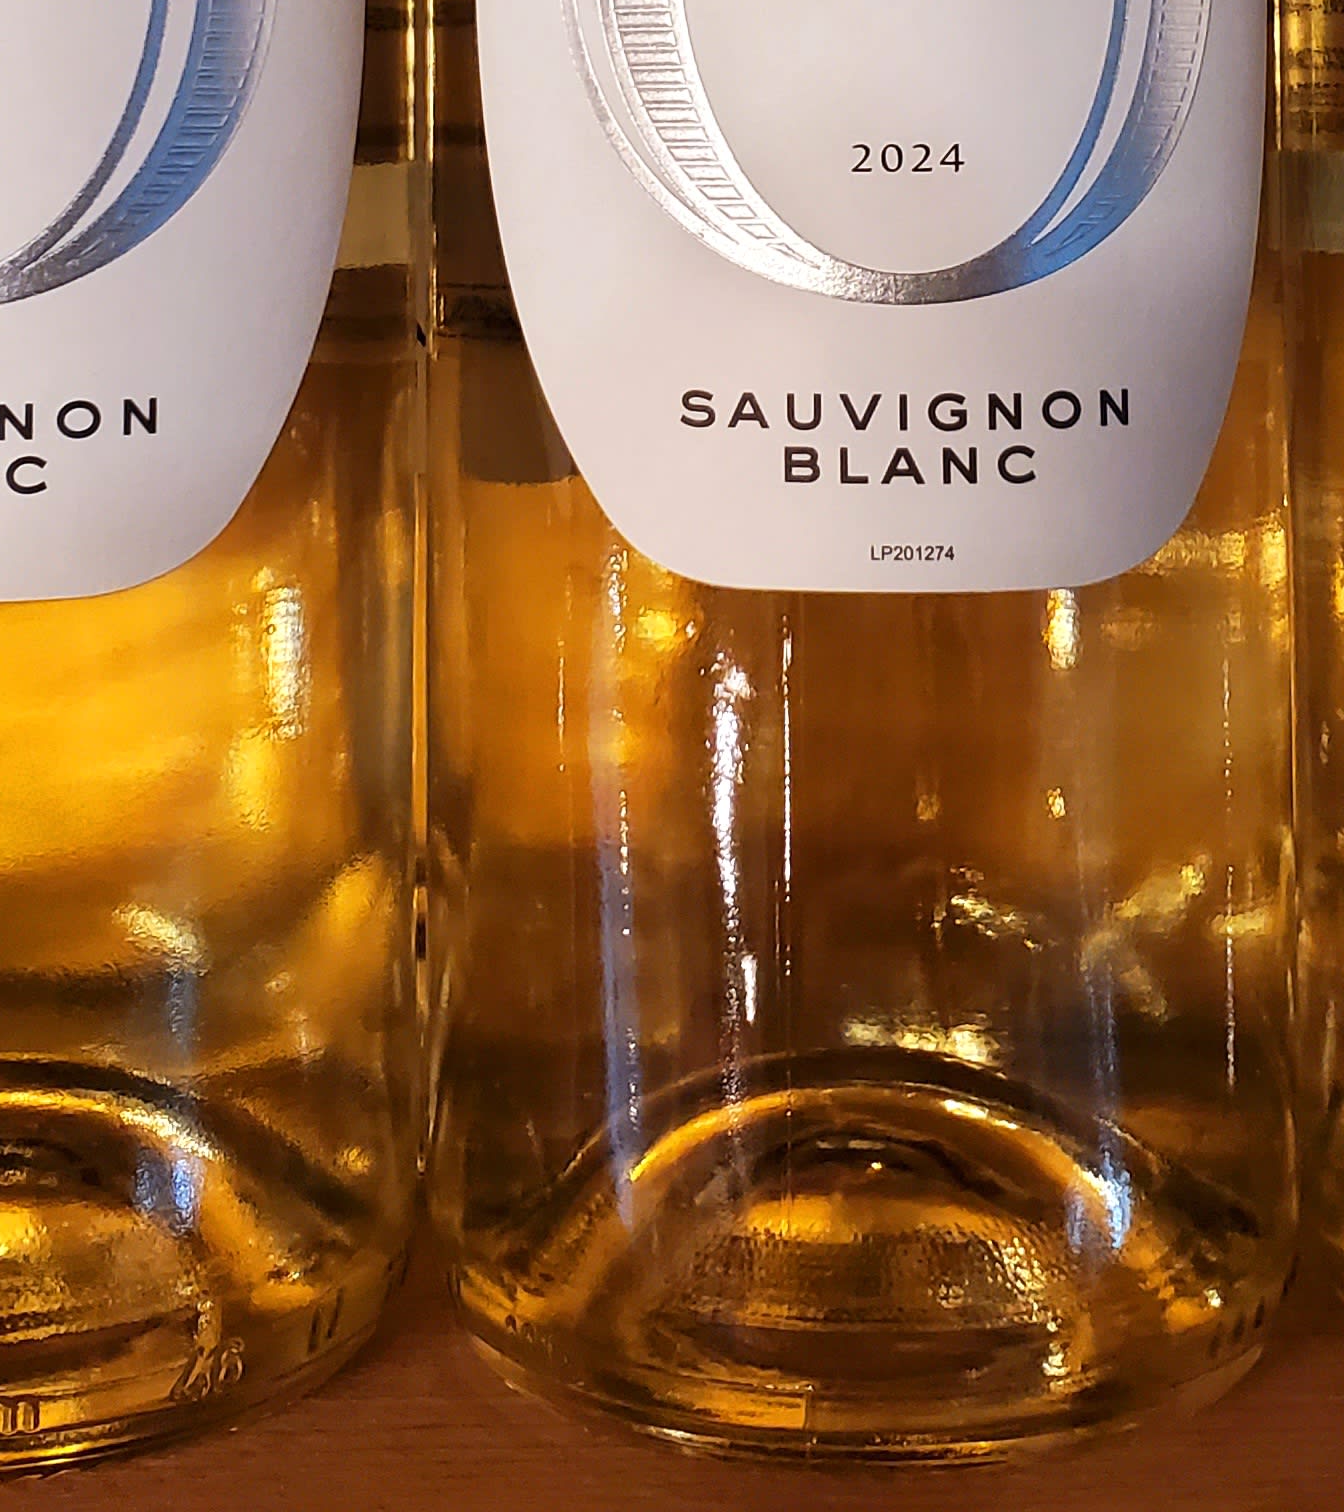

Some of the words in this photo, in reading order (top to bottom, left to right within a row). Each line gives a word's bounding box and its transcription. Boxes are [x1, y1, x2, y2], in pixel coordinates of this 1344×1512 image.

[851, 143, 965, 173] 2024
[680, 387, 1129, 432] SAUVIGNON
[784, 445, 1037, 485] BLANC
[869, 544, 956, 562] LP201274
